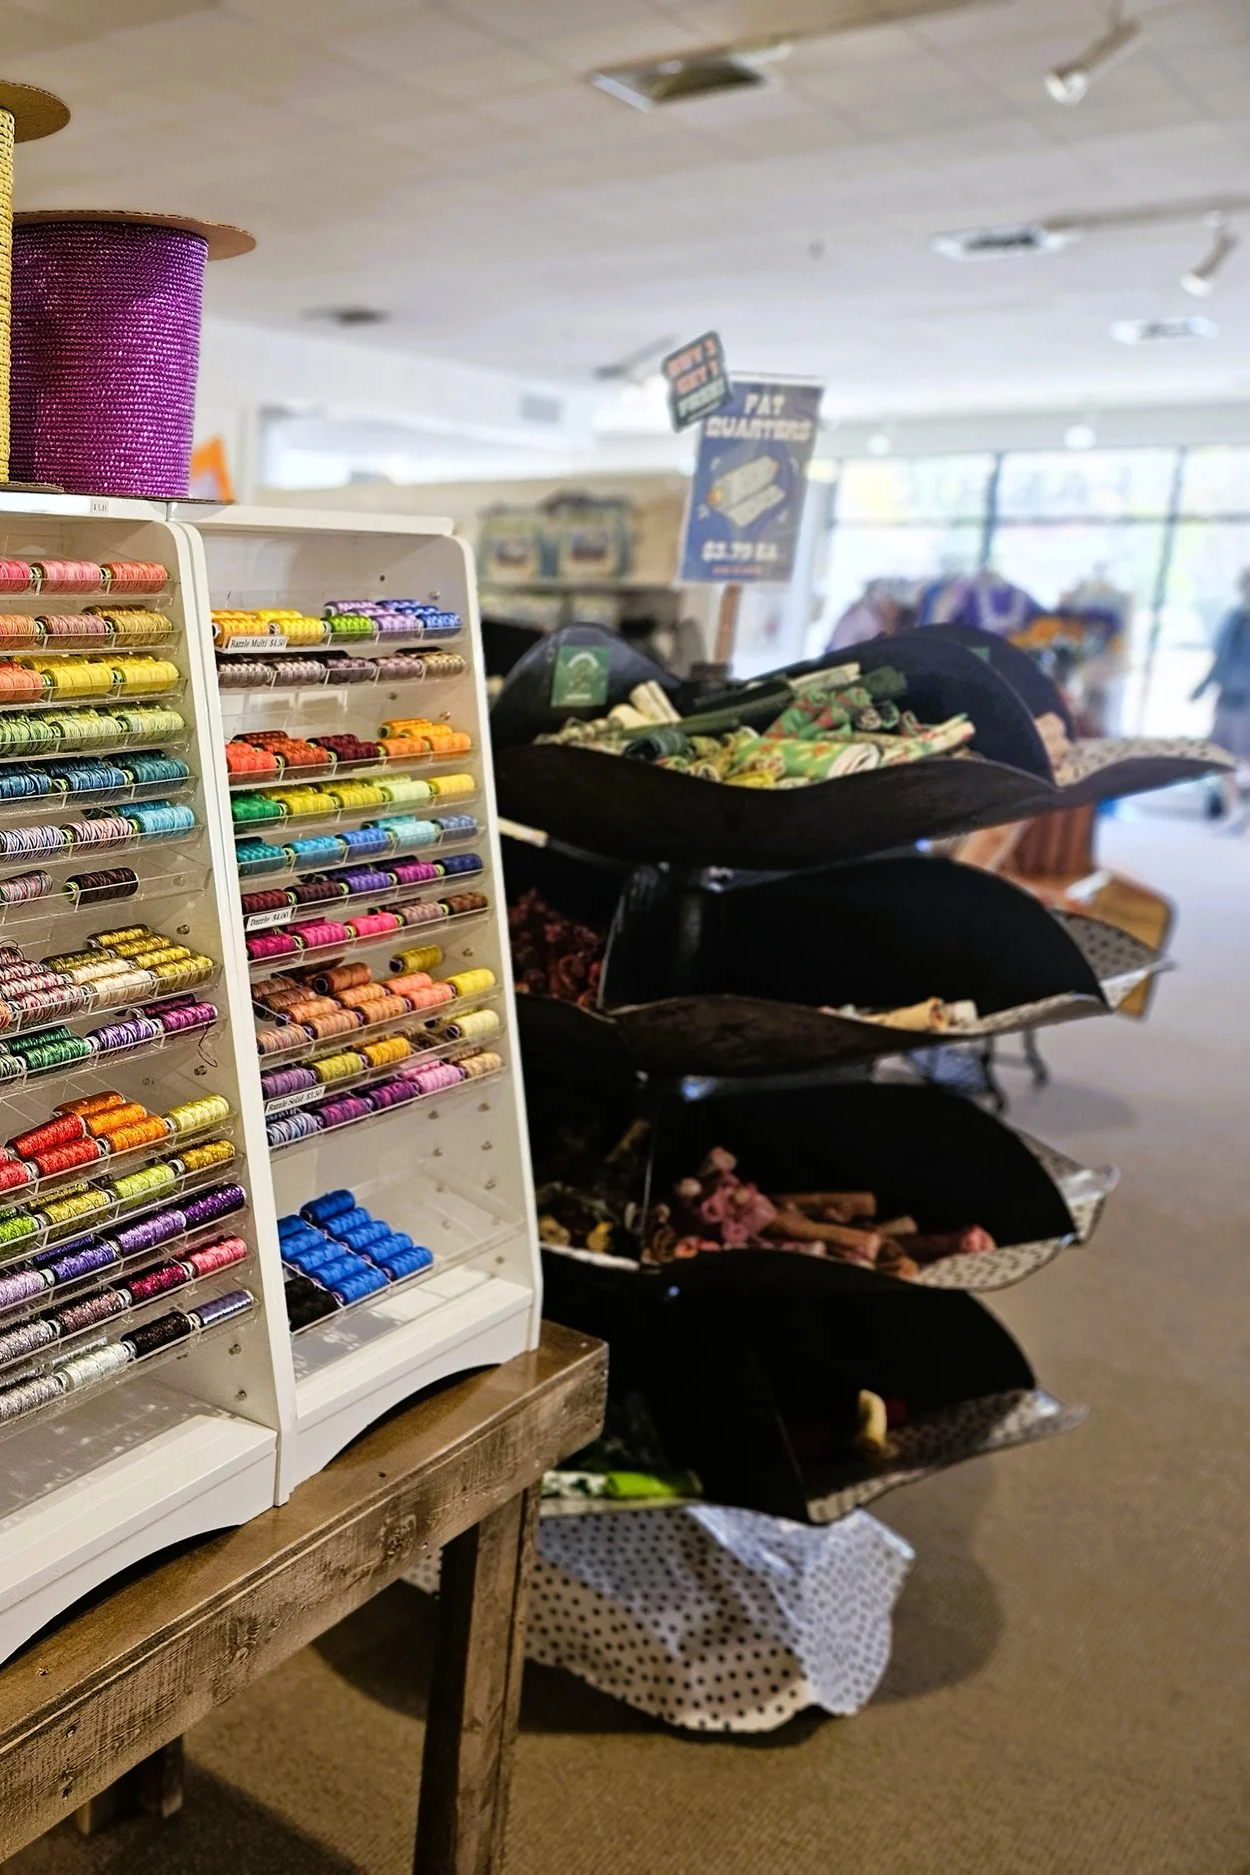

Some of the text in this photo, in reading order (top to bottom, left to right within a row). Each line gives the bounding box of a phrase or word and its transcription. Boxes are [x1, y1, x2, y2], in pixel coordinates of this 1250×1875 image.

[744, 394, 786, 416] FAT
[706, 415, 813, 441] QUARTERS
[251, 639, 267, 648] Multi
